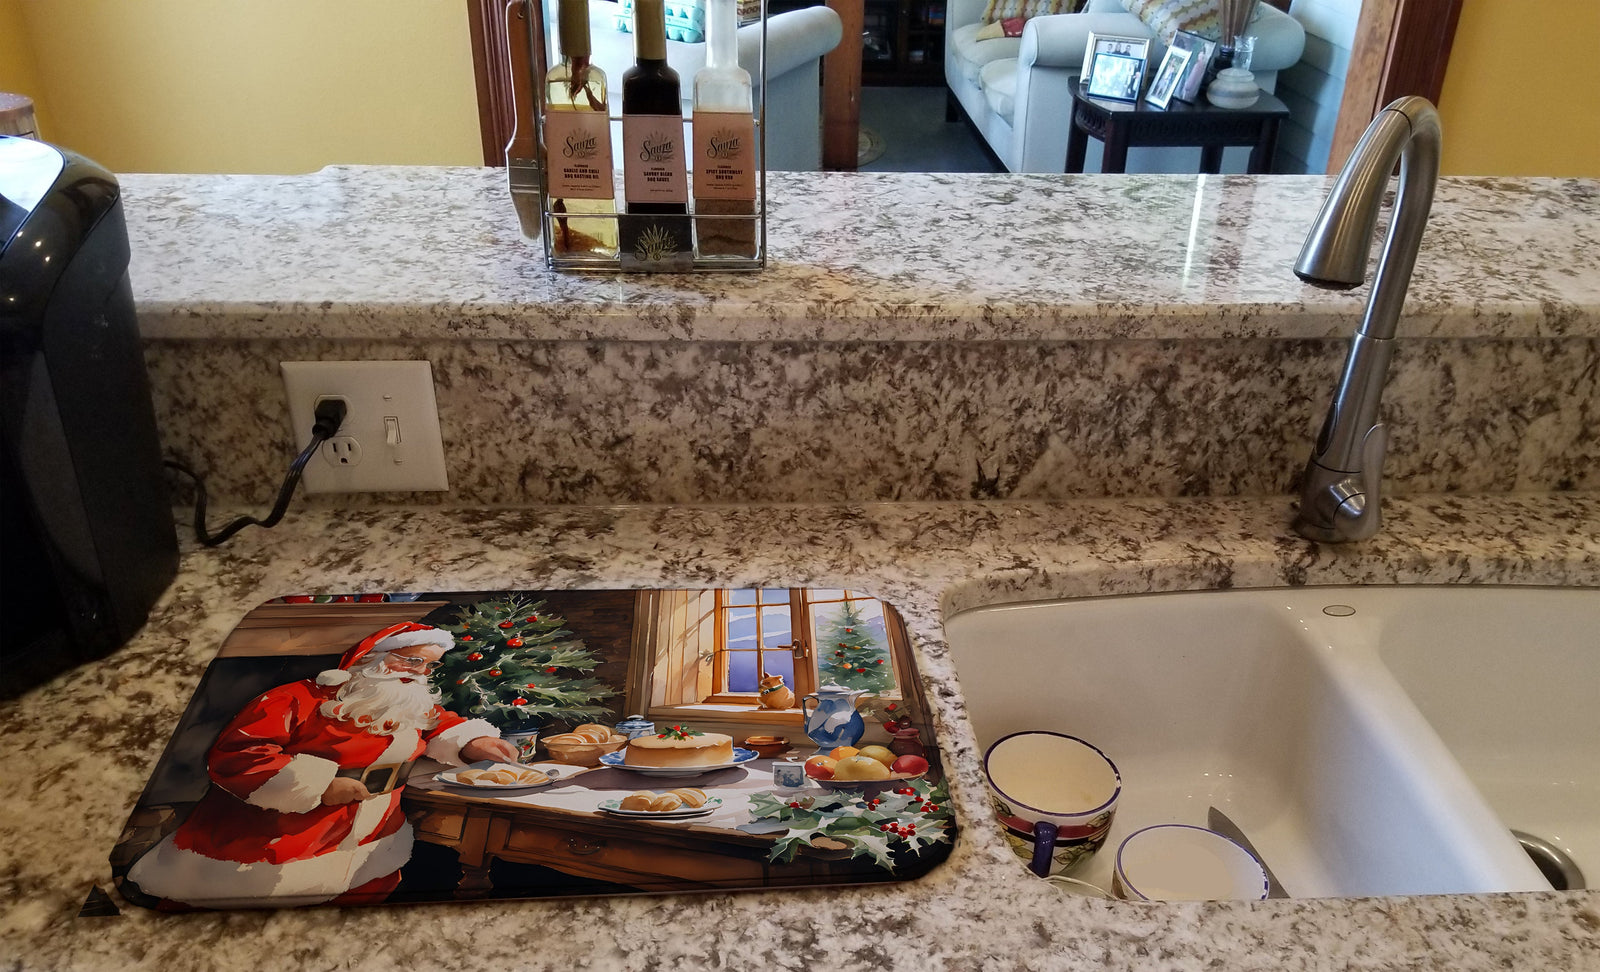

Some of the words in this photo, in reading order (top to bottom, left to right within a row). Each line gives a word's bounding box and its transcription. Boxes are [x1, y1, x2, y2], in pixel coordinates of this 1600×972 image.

[563, 136, 597, 158] Sauza
[640, 140, 673, 161] Sauza
[707, 137, 739, 158] Sauza
